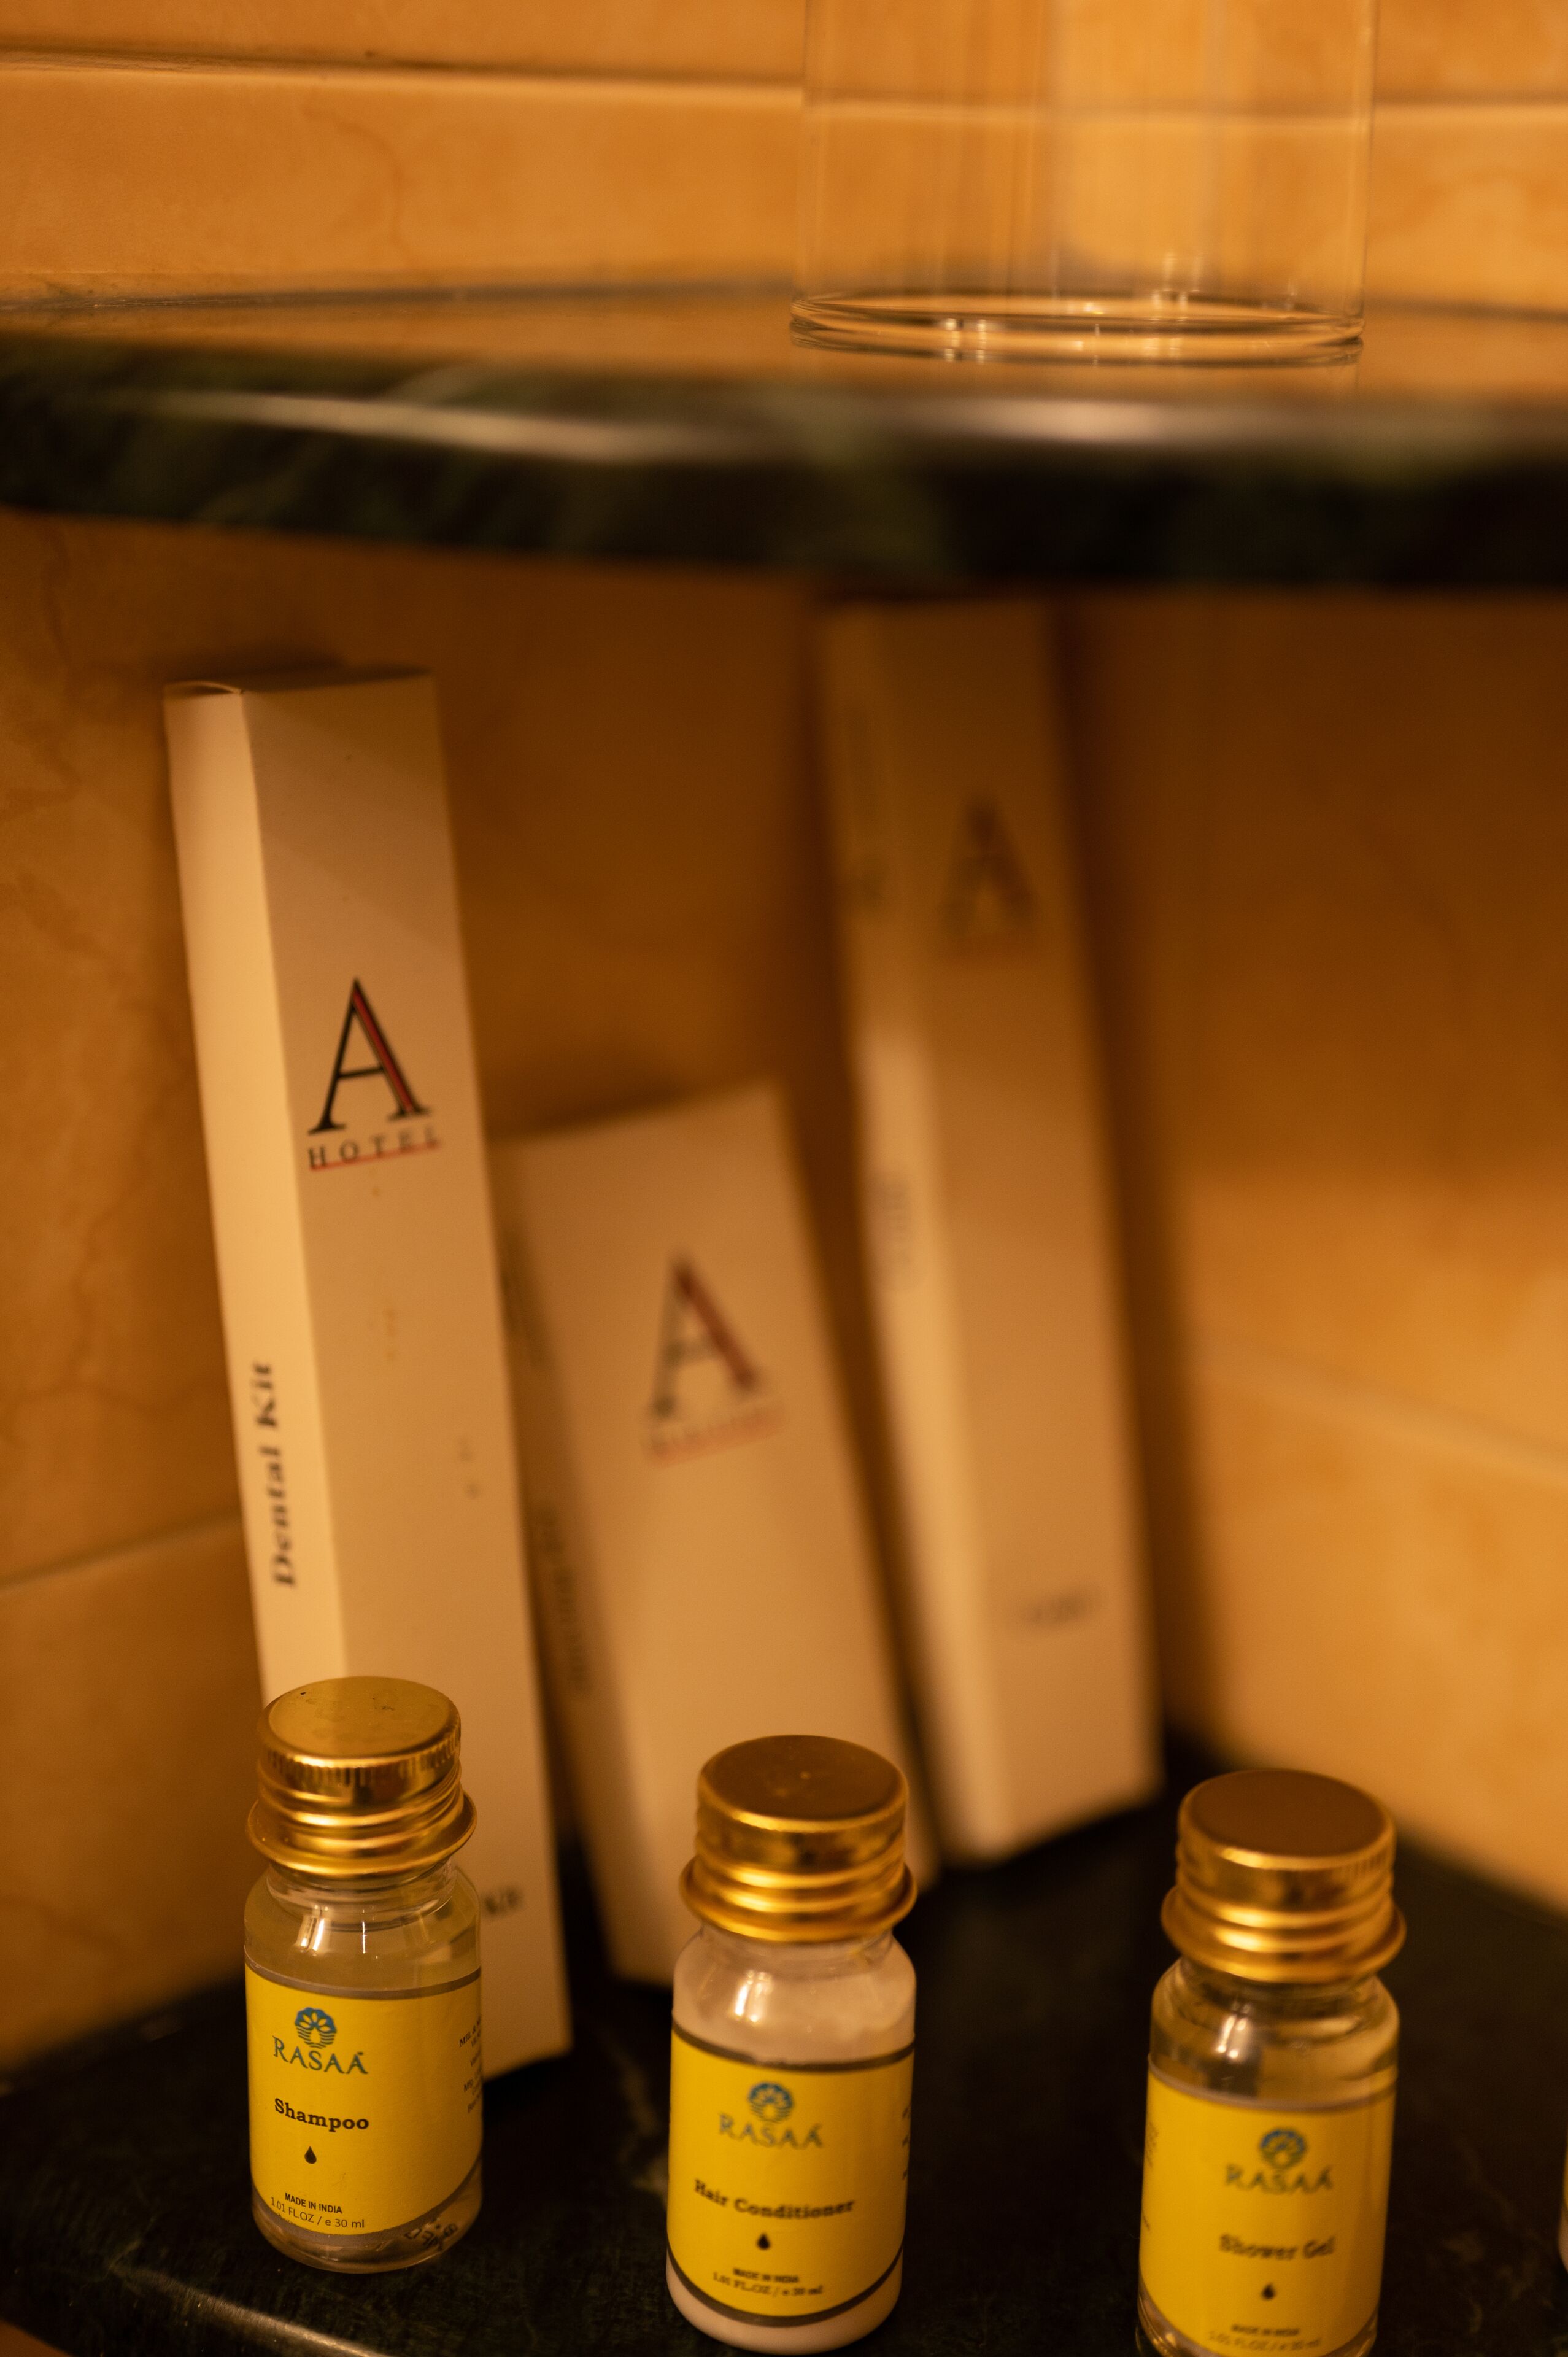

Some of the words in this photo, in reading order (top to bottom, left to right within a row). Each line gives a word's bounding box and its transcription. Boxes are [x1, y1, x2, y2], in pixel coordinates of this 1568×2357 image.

[307, 977, 431, 1135] A
[308, 1127, 438, 1169] HOTEL
[647, 1255, 767, 1421] A
[252, 1361, 277, 1429] Kit
[260, 1444, 296, 1587] Dental
[274, 2098, 369, 2132] Shampoo
[285, 2193, 306, 2208] MADE
[308, 2200, 317, 2210] IN
[319, 2203, 342, 2215] INDIA
[695, 2179, 728, 2206] Hair
[735, 2199, 855, 2220] Conditioner
[334, 2218, 348, 2228] 30
[351, 2218, 365, 2229] ml
[1220, 2234, 1297, 2259] Shower
[1303, 2237, 1337, 2260] Gel
